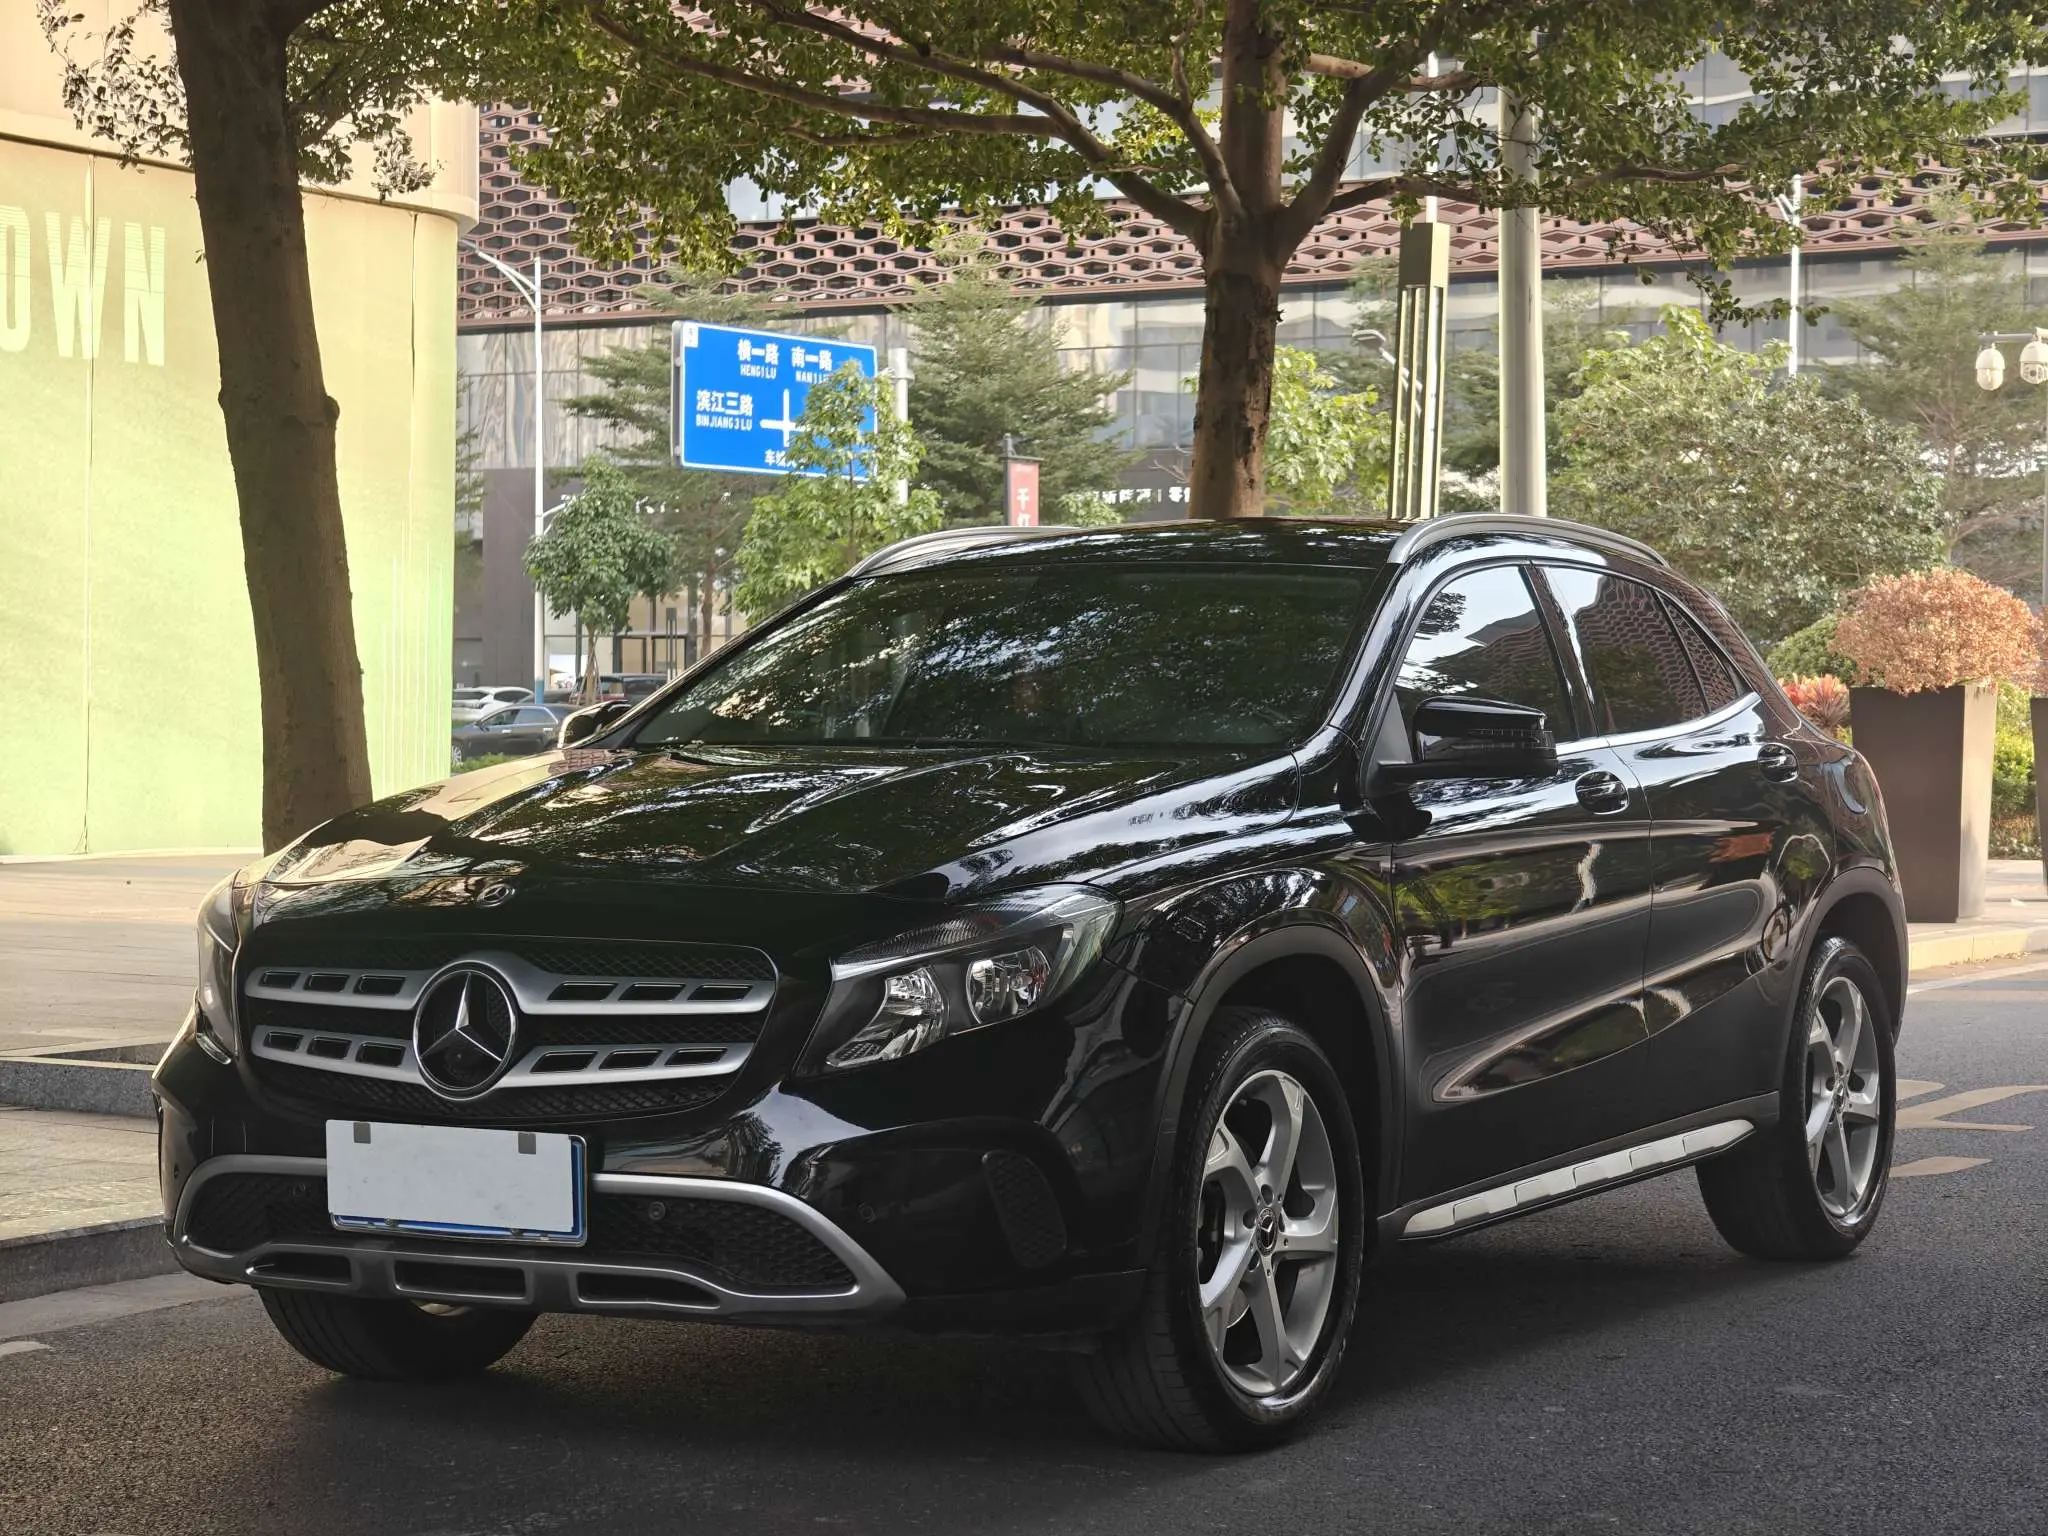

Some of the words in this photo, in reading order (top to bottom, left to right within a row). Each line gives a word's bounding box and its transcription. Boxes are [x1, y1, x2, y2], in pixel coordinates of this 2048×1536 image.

[0, 204, 165, 367] OWN
[791, 346, 833, 372] 南一路
[696, 388, 754, 416] 滨江三路
